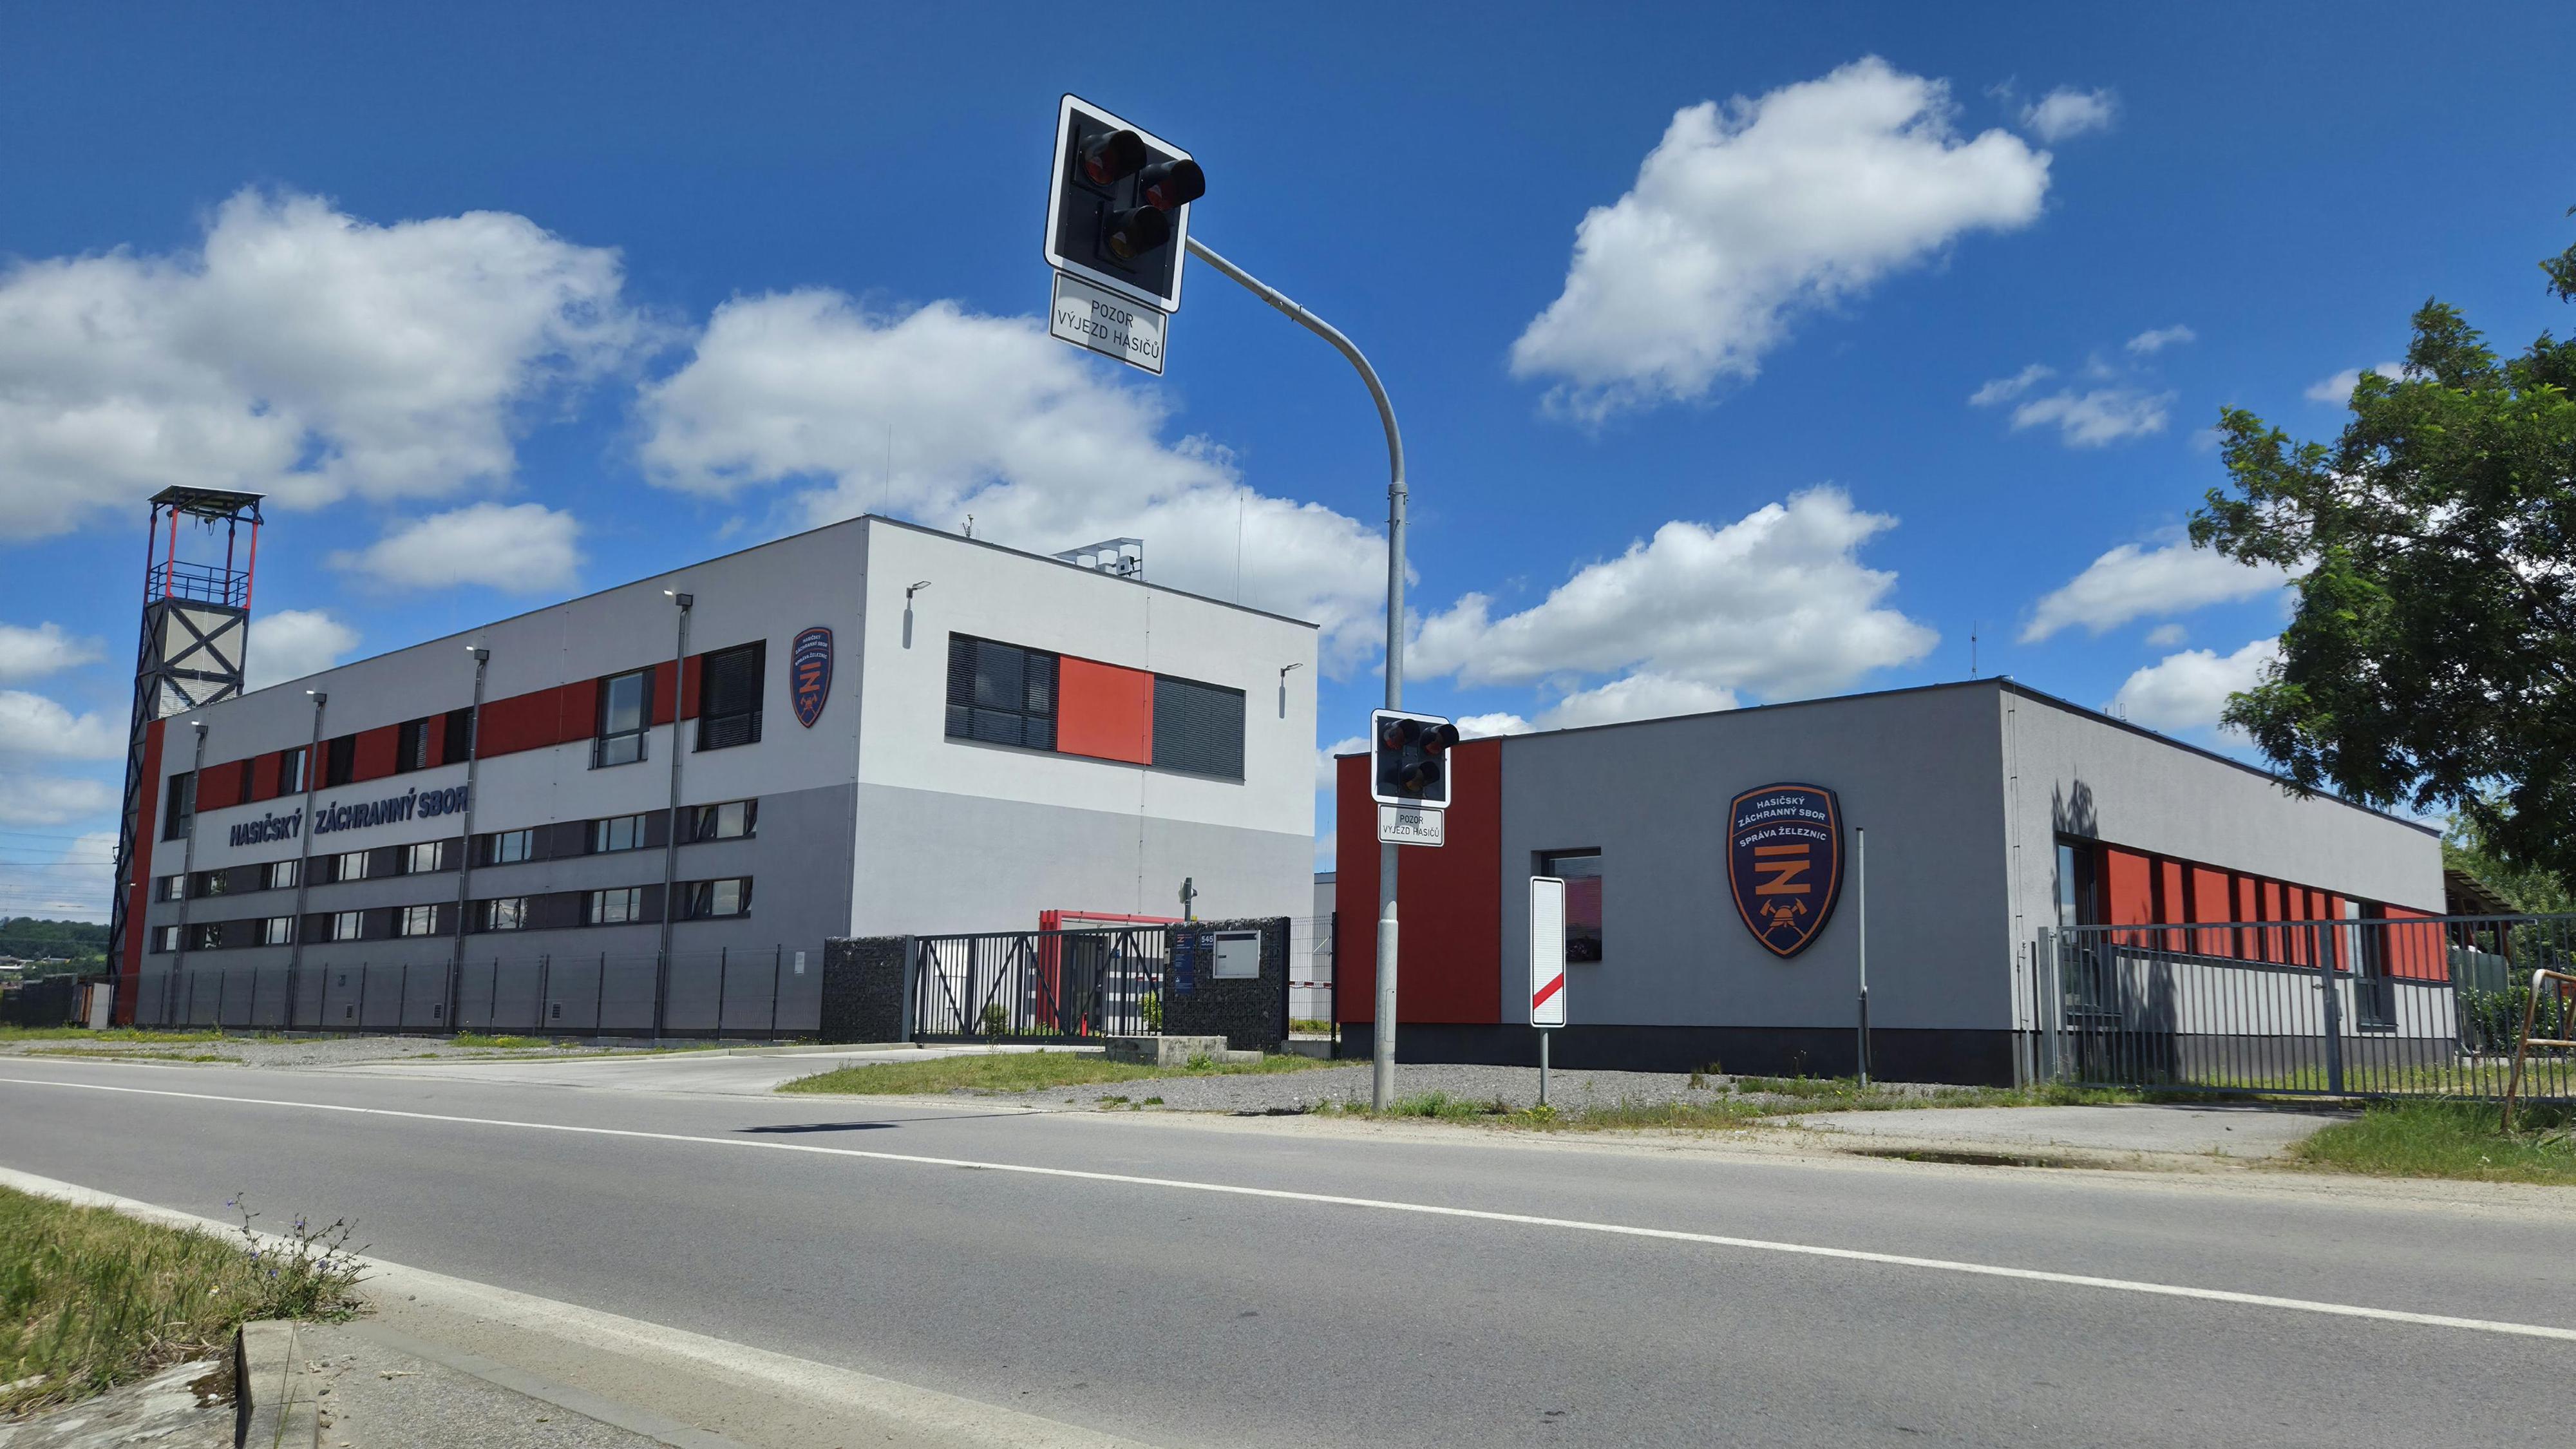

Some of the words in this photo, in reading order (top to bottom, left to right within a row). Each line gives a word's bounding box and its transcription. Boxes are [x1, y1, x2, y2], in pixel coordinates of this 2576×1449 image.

[1091, 299, 1134, 328] POZOR
[1057, 309, 1108, 339] VÝJEZD
[1113, 330, 1159, 359] HASIČŮ
[1757, 796, 1805, 809] HASIČSKÝ
[229, 808, 302, 847] HASIČSKÝ
[314, 787, 417, 835] ZÁCHRANNÝ
[417, 786, 469, 819] SBOR
[1399, 814, 1424, 825] POZOR
[1738, 806, 1797, 828] ZÁCHRANNÝ
[1799, 809, 1826, 820] SBOR
[1383, 825, 1410, 835] VÝJEZD
[1413, 827, 1440, 838] HASIČŮ
[1739, 828, 1777, 848] SPRÁVA
[1778, 826, 1827, 841] ŽELEZNIC
